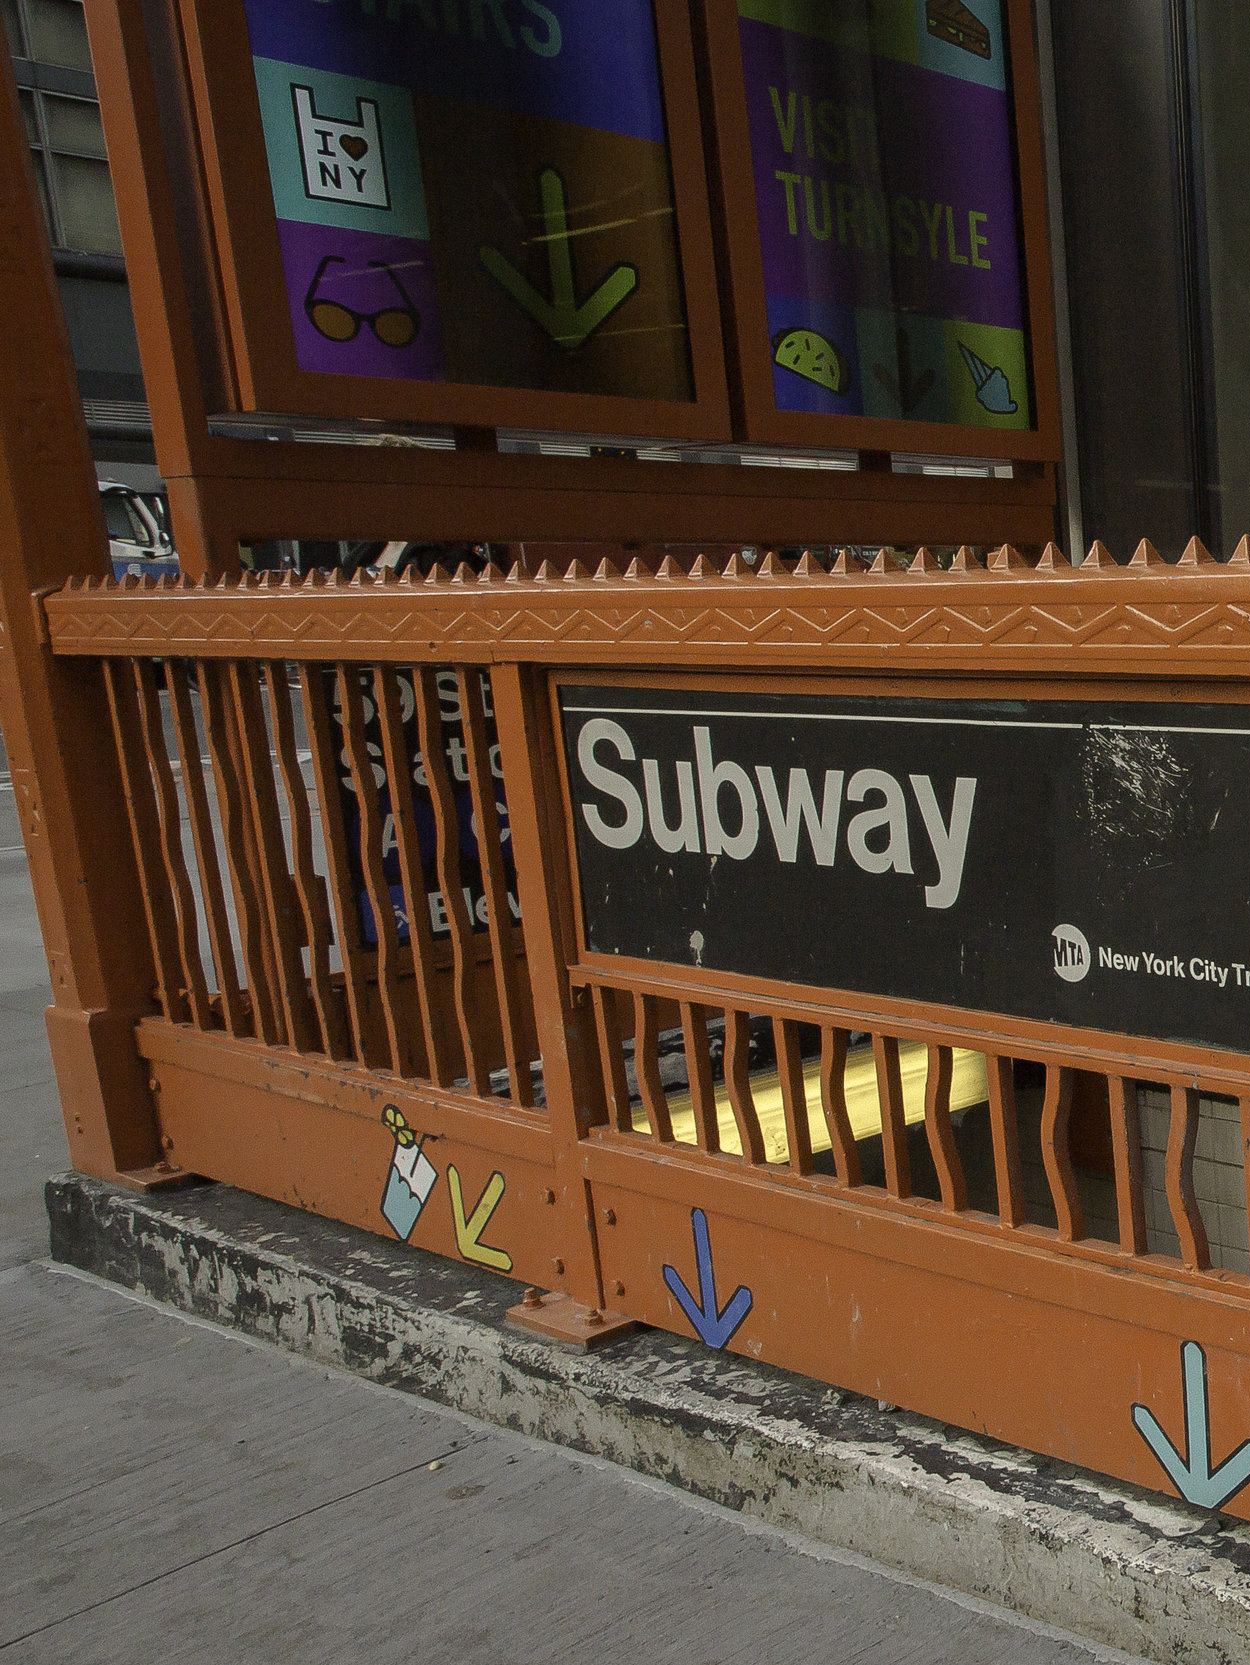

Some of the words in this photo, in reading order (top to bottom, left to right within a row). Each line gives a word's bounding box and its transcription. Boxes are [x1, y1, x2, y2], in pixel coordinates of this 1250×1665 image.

[315, 128, 336, 158] I
[318, 160, 368, 194] NY
[577, 718, 977, 909] Subway
[1098, 946, 1139, 972] New
[1142, 951, 1186, 978] York
[1189, 957, 1229, 988] City
